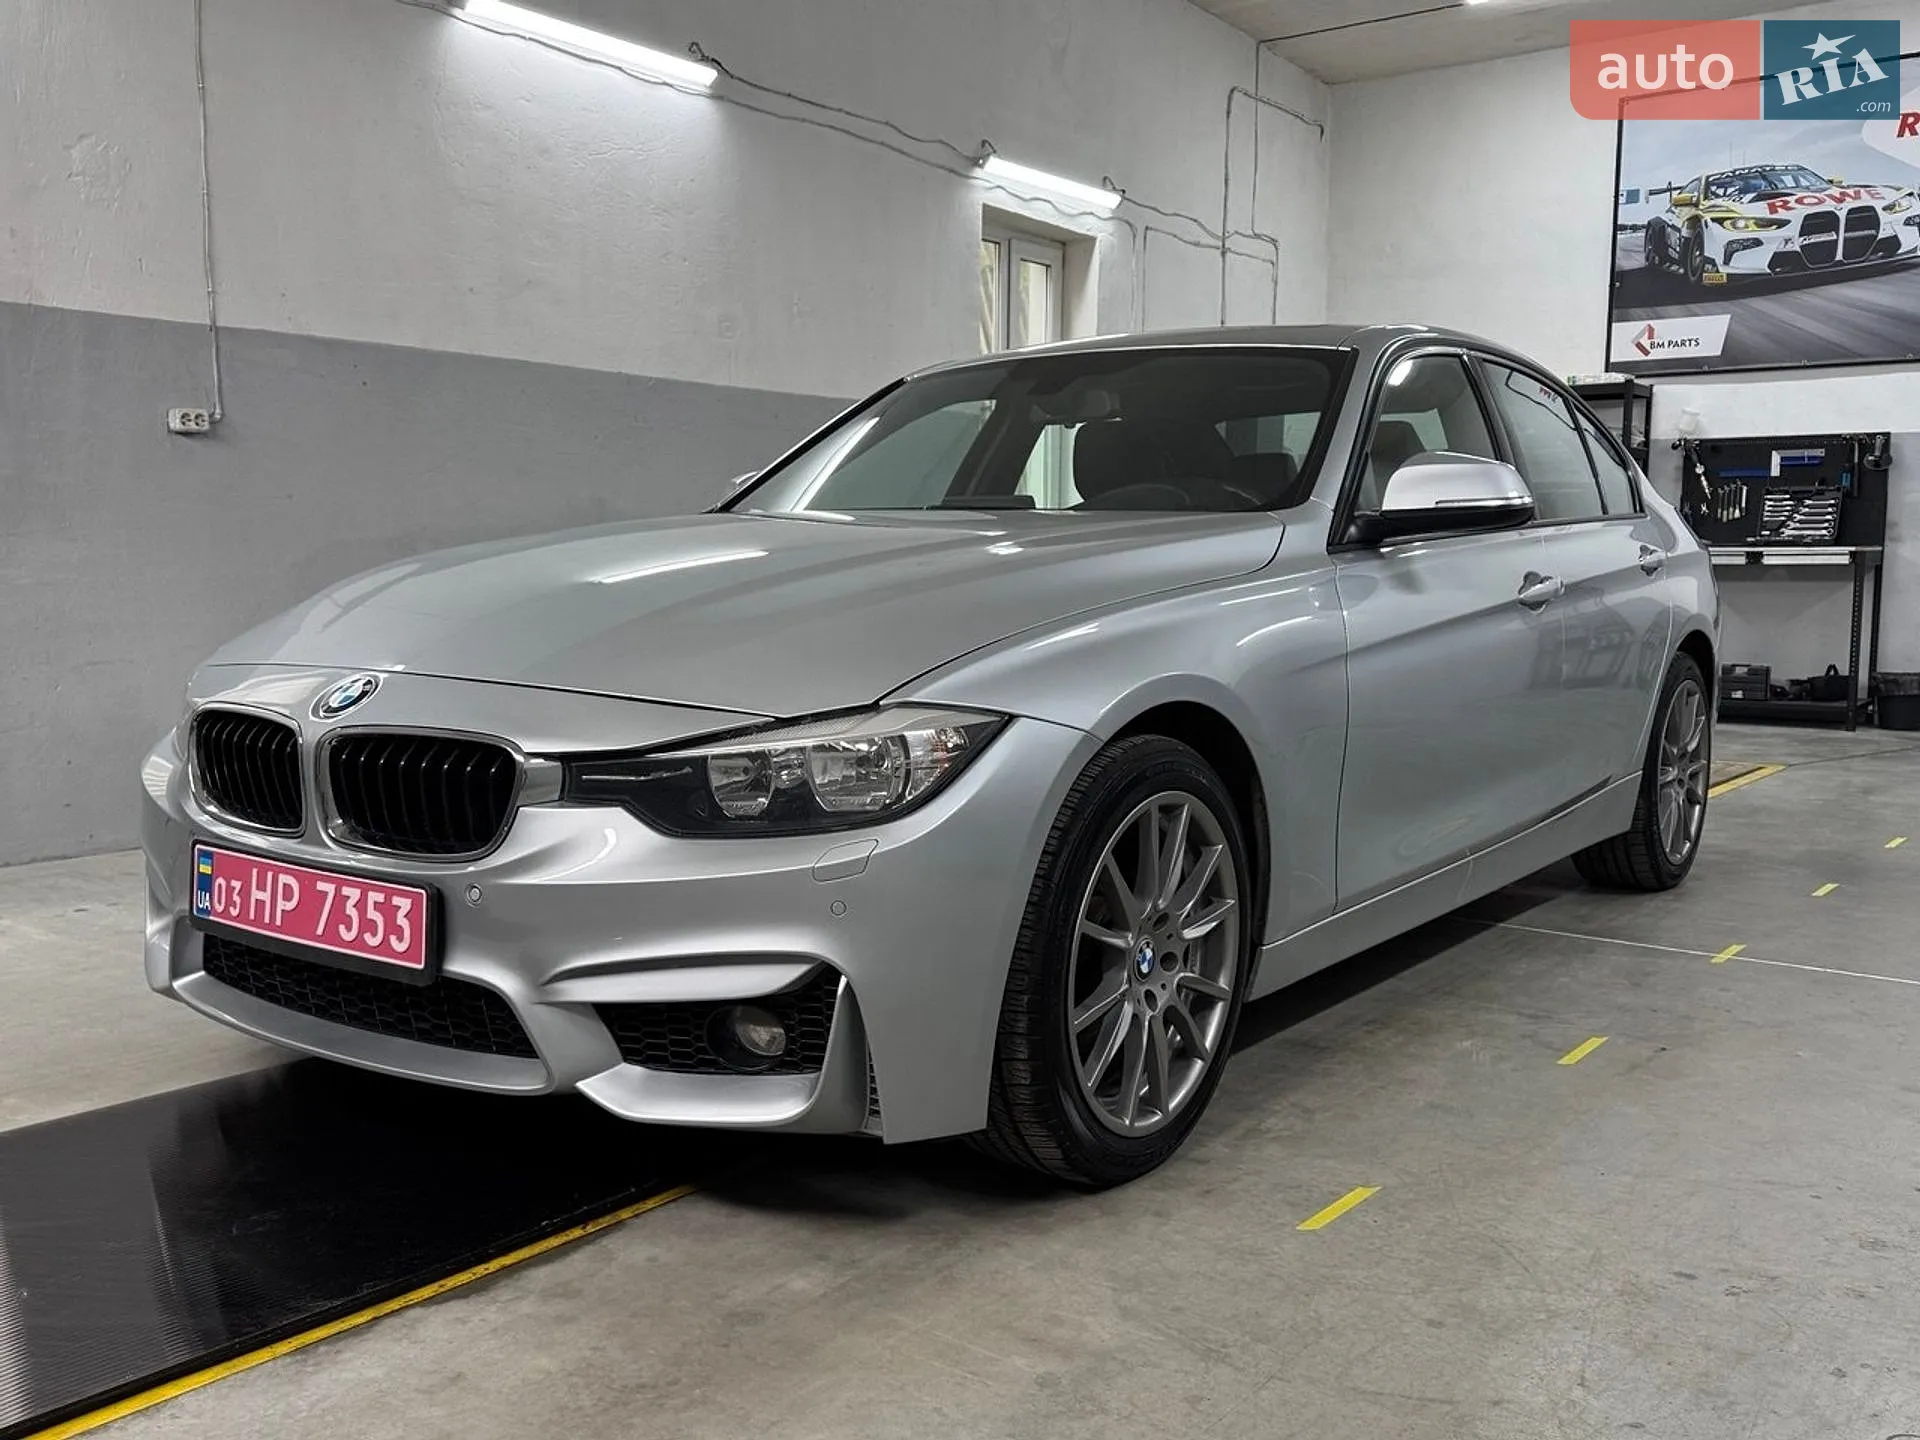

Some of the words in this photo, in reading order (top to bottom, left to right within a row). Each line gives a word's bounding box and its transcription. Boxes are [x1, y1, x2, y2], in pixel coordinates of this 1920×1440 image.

[1766, 188, 1885, 215] ROWE
[1650, 340, 1665, 350] BM
[1667, 337, 1701, 349] PARTS
[198, 890, 211, 910] UA
[214, 876, 242, 917] 03
[249, 867, 300, 926] HP
[315, 880, 412, 953] 7353
